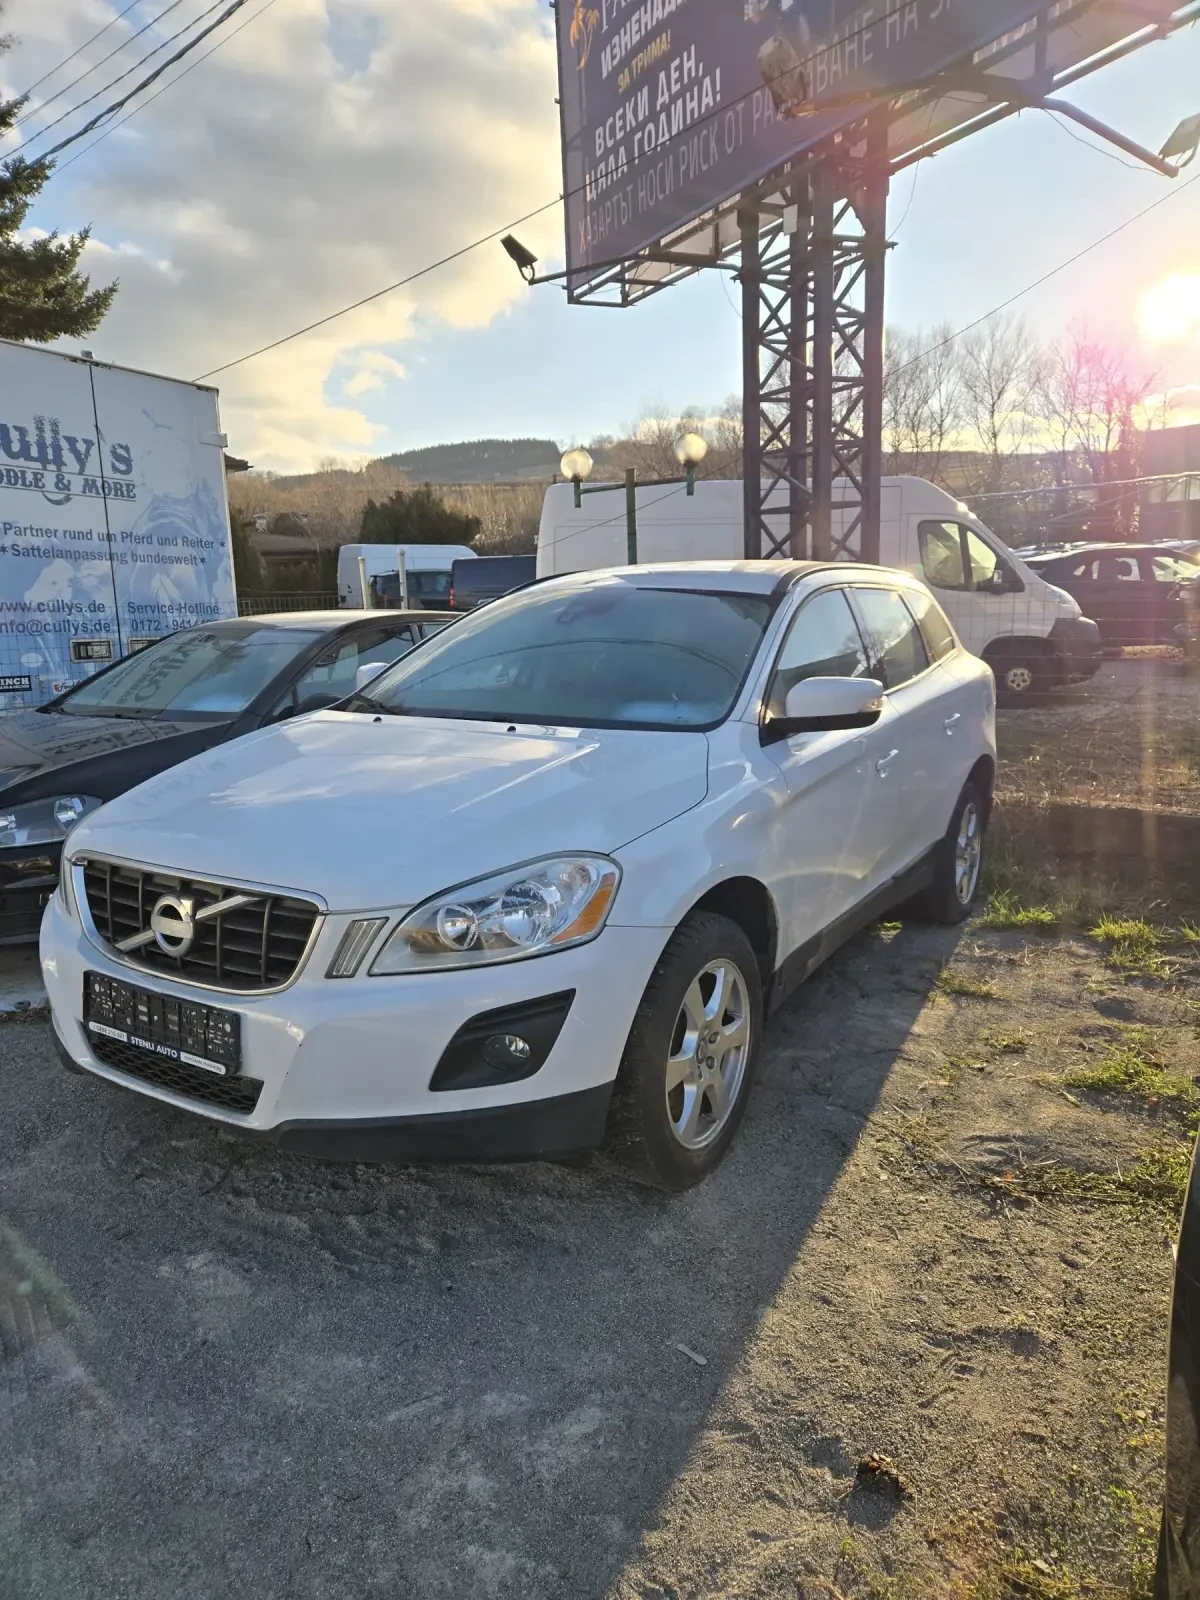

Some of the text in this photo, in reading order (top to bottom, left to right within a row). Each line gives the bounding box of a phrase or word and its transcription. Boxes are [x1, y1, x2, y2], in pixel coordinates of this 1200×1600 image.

[601, 0, 685, 80] ИЗНЕНАД
[617, 28, 671, 94] ЗА ТРИМА!
[595, 43, 703, 158] ВСЕКИ ДЕН,
[578, 184, 633, 253] ХАЗАРТЪТ
[638, 154, 674, 214] НОСИ
[679, 125, 719, 188] РИСК
[724, 101, 745, 155] ОТ
[753, 7, 873, 136] РАВАНЕ
[585, 66, 721, 202] ЦЯЛА ГОДИНА!
[54, 473, 71, 492] &
[82, 478, 136, 499] MORE
[3, 522, 214, 549] Partner rund um Pferd und Reiter
[11, 543, 198, 566] Sattelanpassung bundesweit
[128, 601, 219, 615] Service-Hotline
[132, 619, 161, 632] 0172
[130, 1036, 178, 1058] STENLI AUTO
